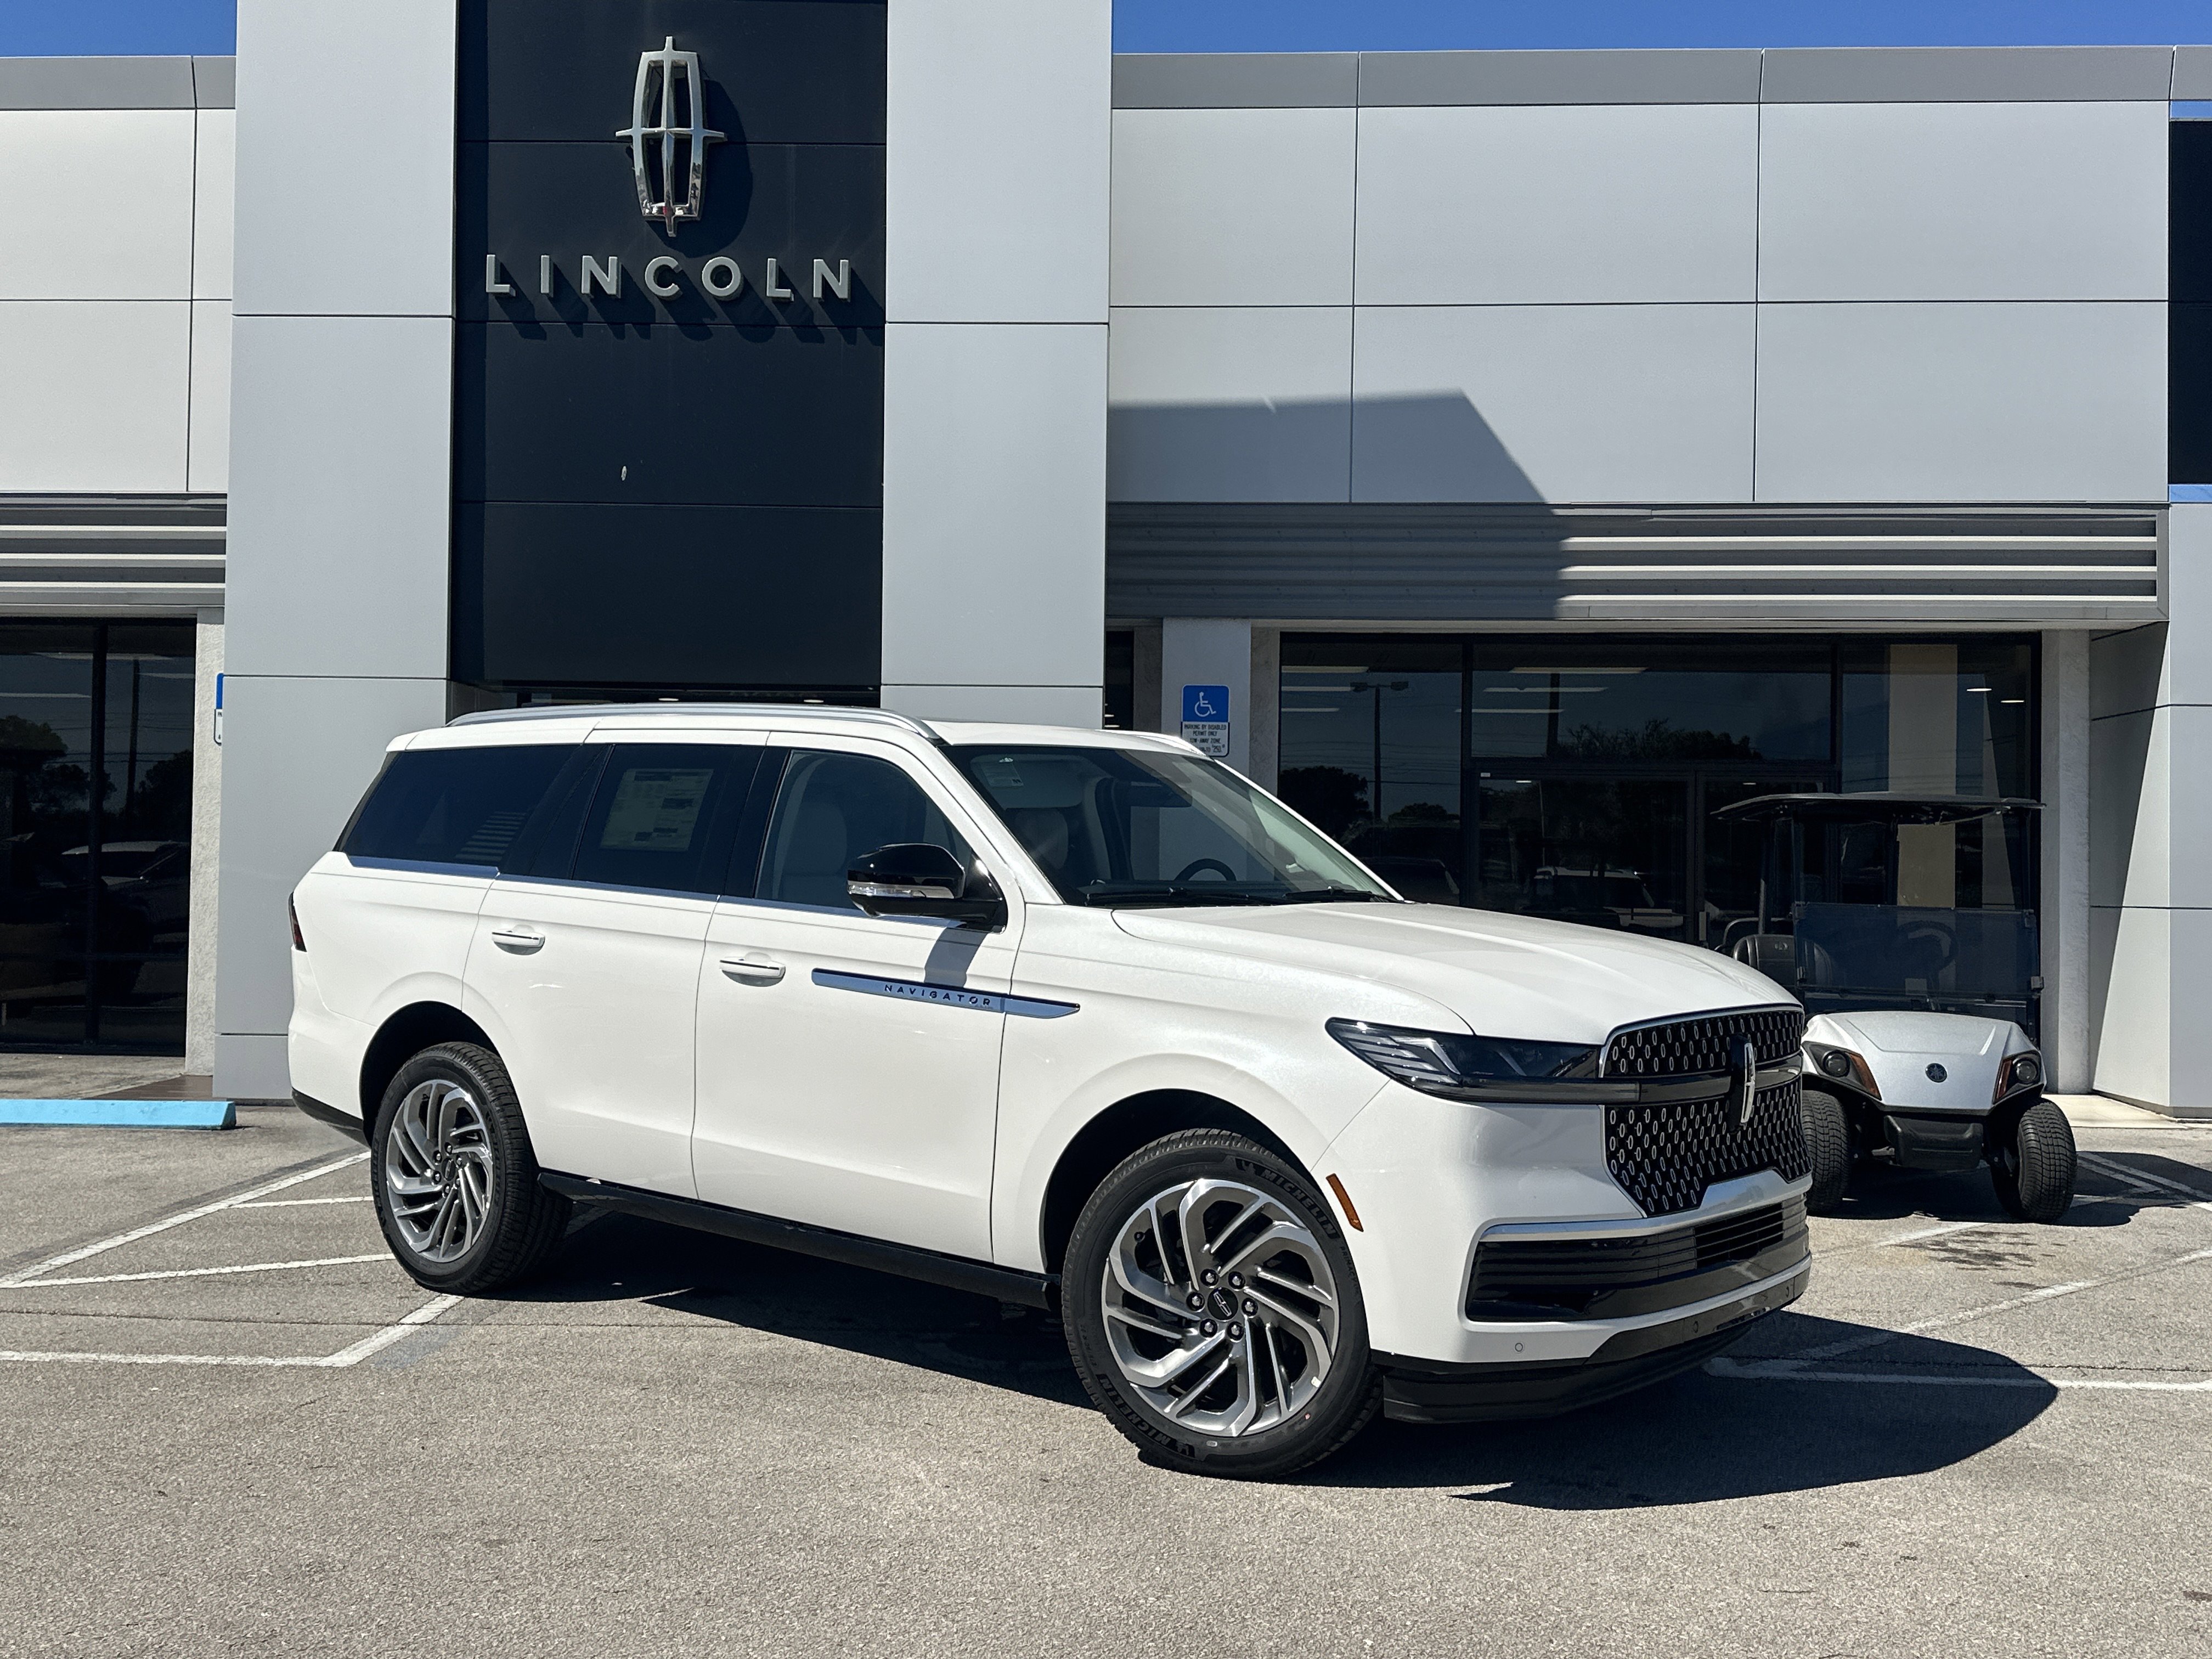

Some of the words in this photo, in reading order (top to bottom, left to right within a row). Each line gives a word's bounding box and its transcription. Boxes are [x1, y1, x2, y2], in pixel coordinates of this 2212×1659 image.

[486, 254, 851, 300] LINCOLN
[884, 984, 991, 1006] NAVIGATOR
[1262, 1169, 1337, 1237] MICHELIN
[1340, 1246, 1357, 1282] PRIMACY
[1099, 1378, 1171, 1445] MICHELIN
